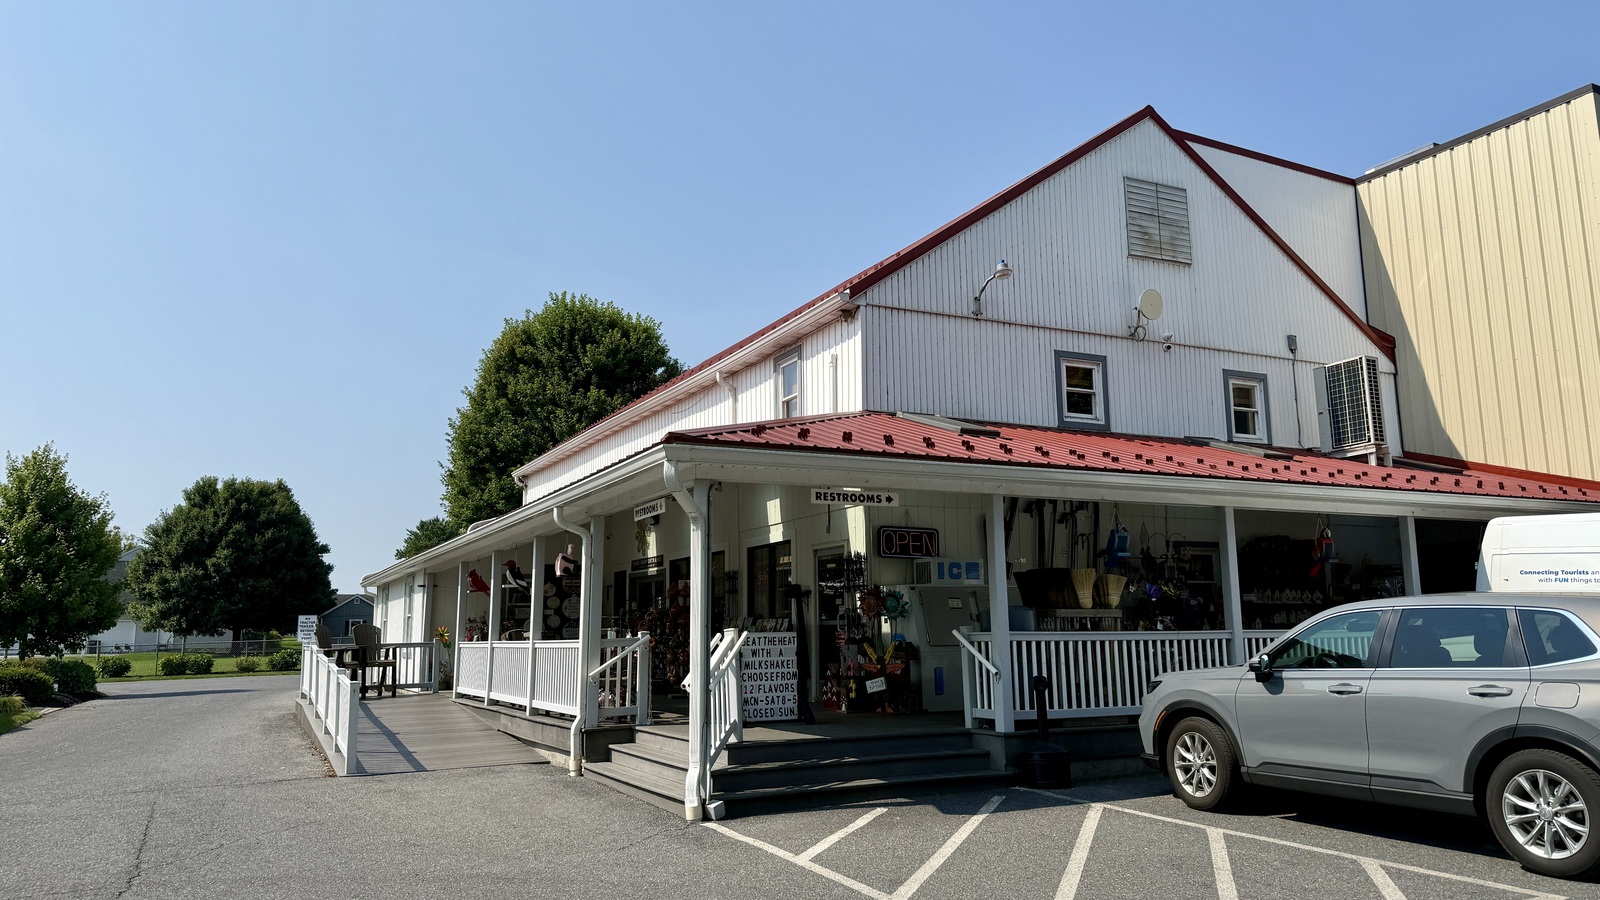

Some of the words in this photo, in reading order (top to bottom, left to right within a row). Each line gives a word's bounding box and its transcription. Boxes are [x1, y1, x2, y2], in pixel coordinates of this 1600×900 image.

[815, 491, 883, 504] RESTROOMS
[635, 503, 658, 518] RESTROOMS
[883, 531, 938, 557] OPEN
[937, 561, 981, 580] ICE
[751, 648, 772, 658] WITH
[778, 648, 784, 657] A
[743, 659, 794, 670] MILKSHAKE!
[744, 684, 755, 694] 12
[757, 683, 795, 694] FLAVORS
[743, 707, 775, 719] CLOSED
[778, 706, 798, 717] SUN.
